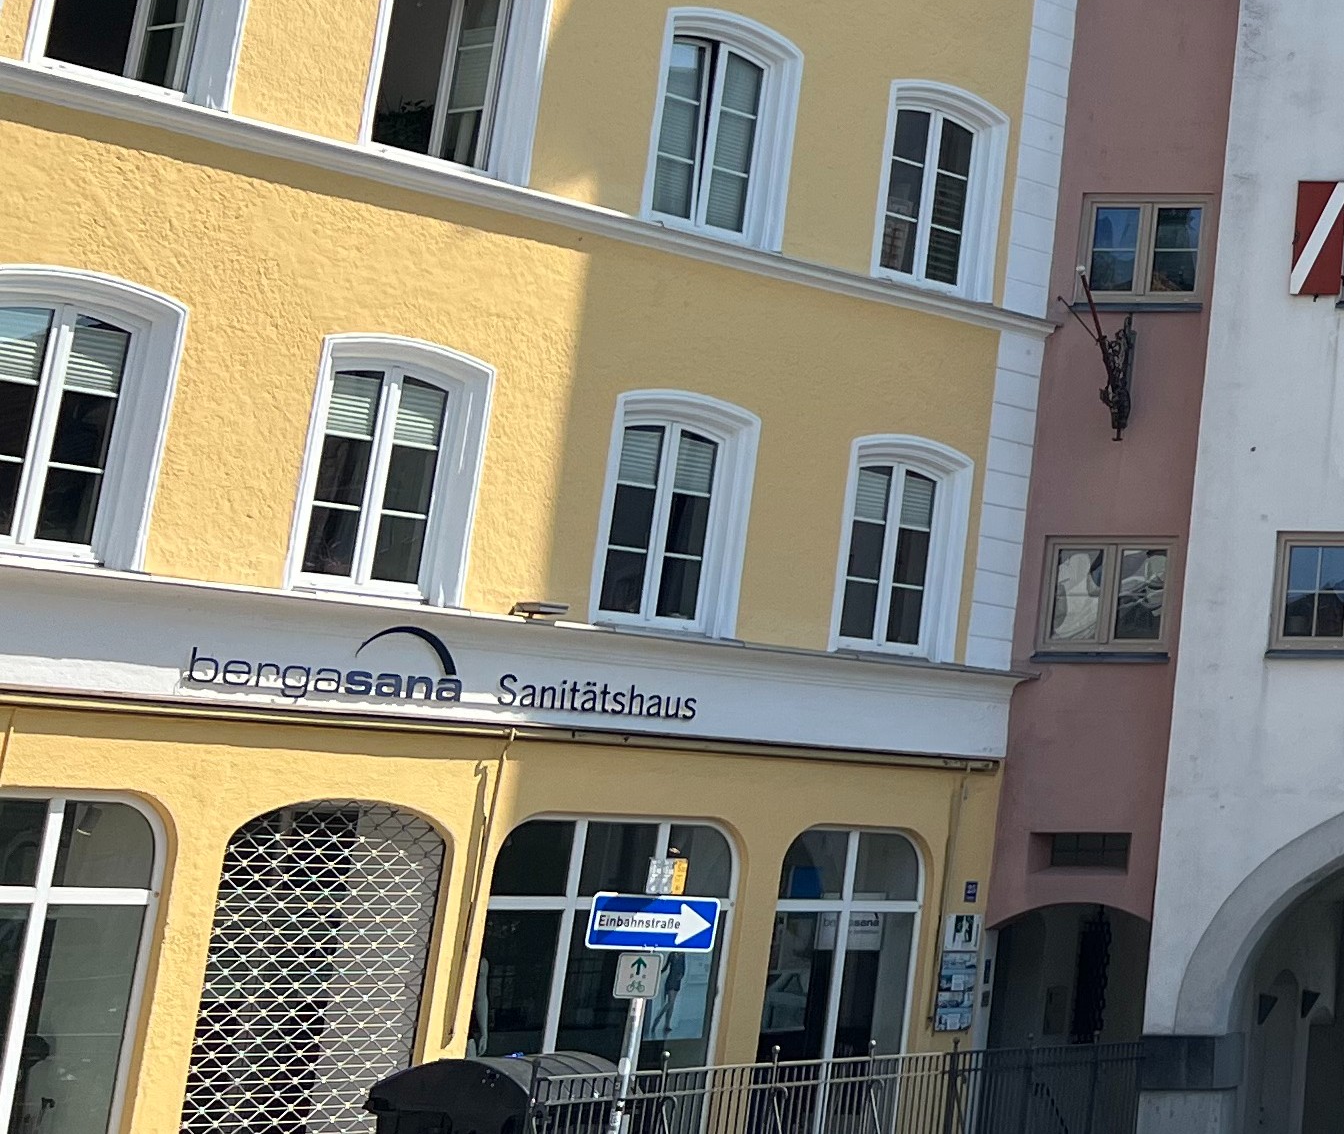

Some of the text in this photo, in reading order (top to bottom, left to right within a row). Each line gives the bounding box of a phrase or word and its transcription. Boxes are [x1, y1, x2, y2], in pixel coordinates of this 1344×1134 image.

[188, 647, 698, 721] bergasana Sanitätshaus
[598, 914, 681, 930] Einbahnstraße
